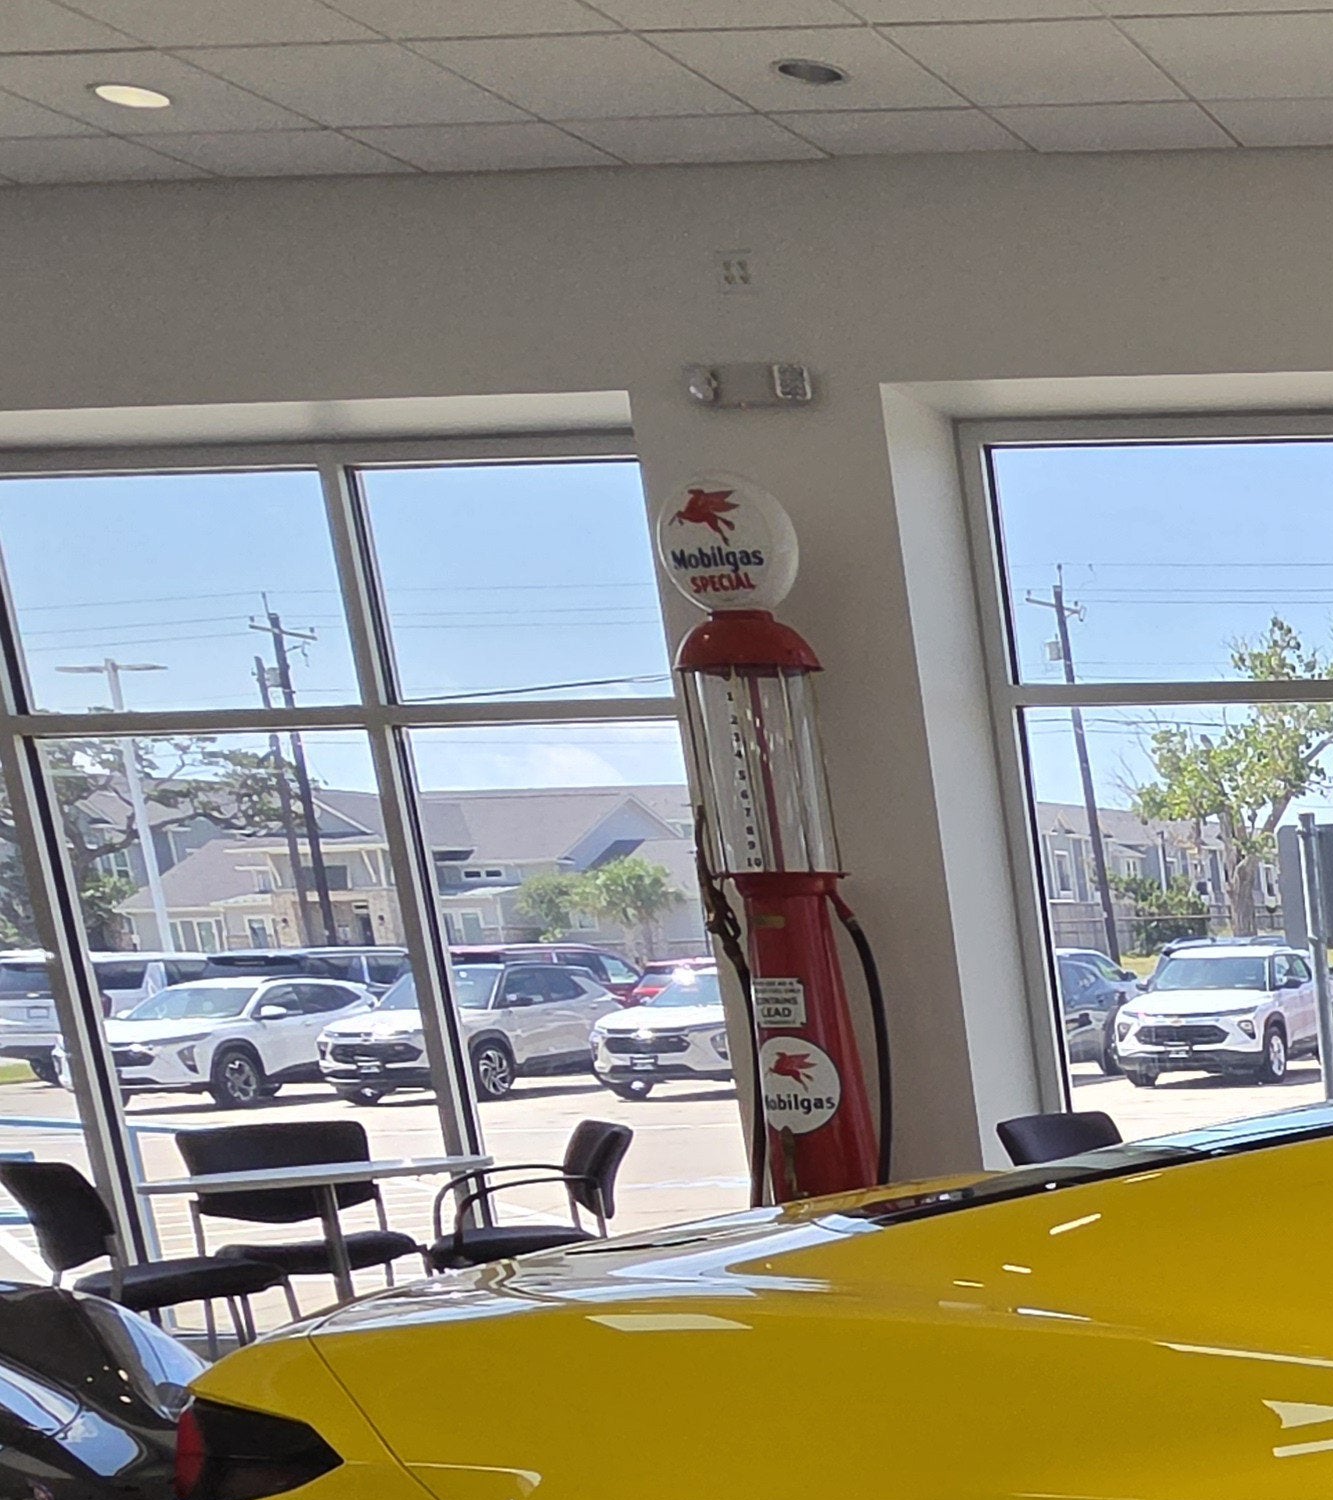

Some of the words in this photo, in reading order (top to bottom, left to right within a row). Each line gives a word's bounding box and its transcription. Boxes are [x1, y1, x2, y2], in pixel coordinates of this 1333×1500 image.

[671, 546, 764, 571] Mobilgas
[690, 572, 755, 593] SPECIAL
[761, 1007, 792, 1018] LEAD
